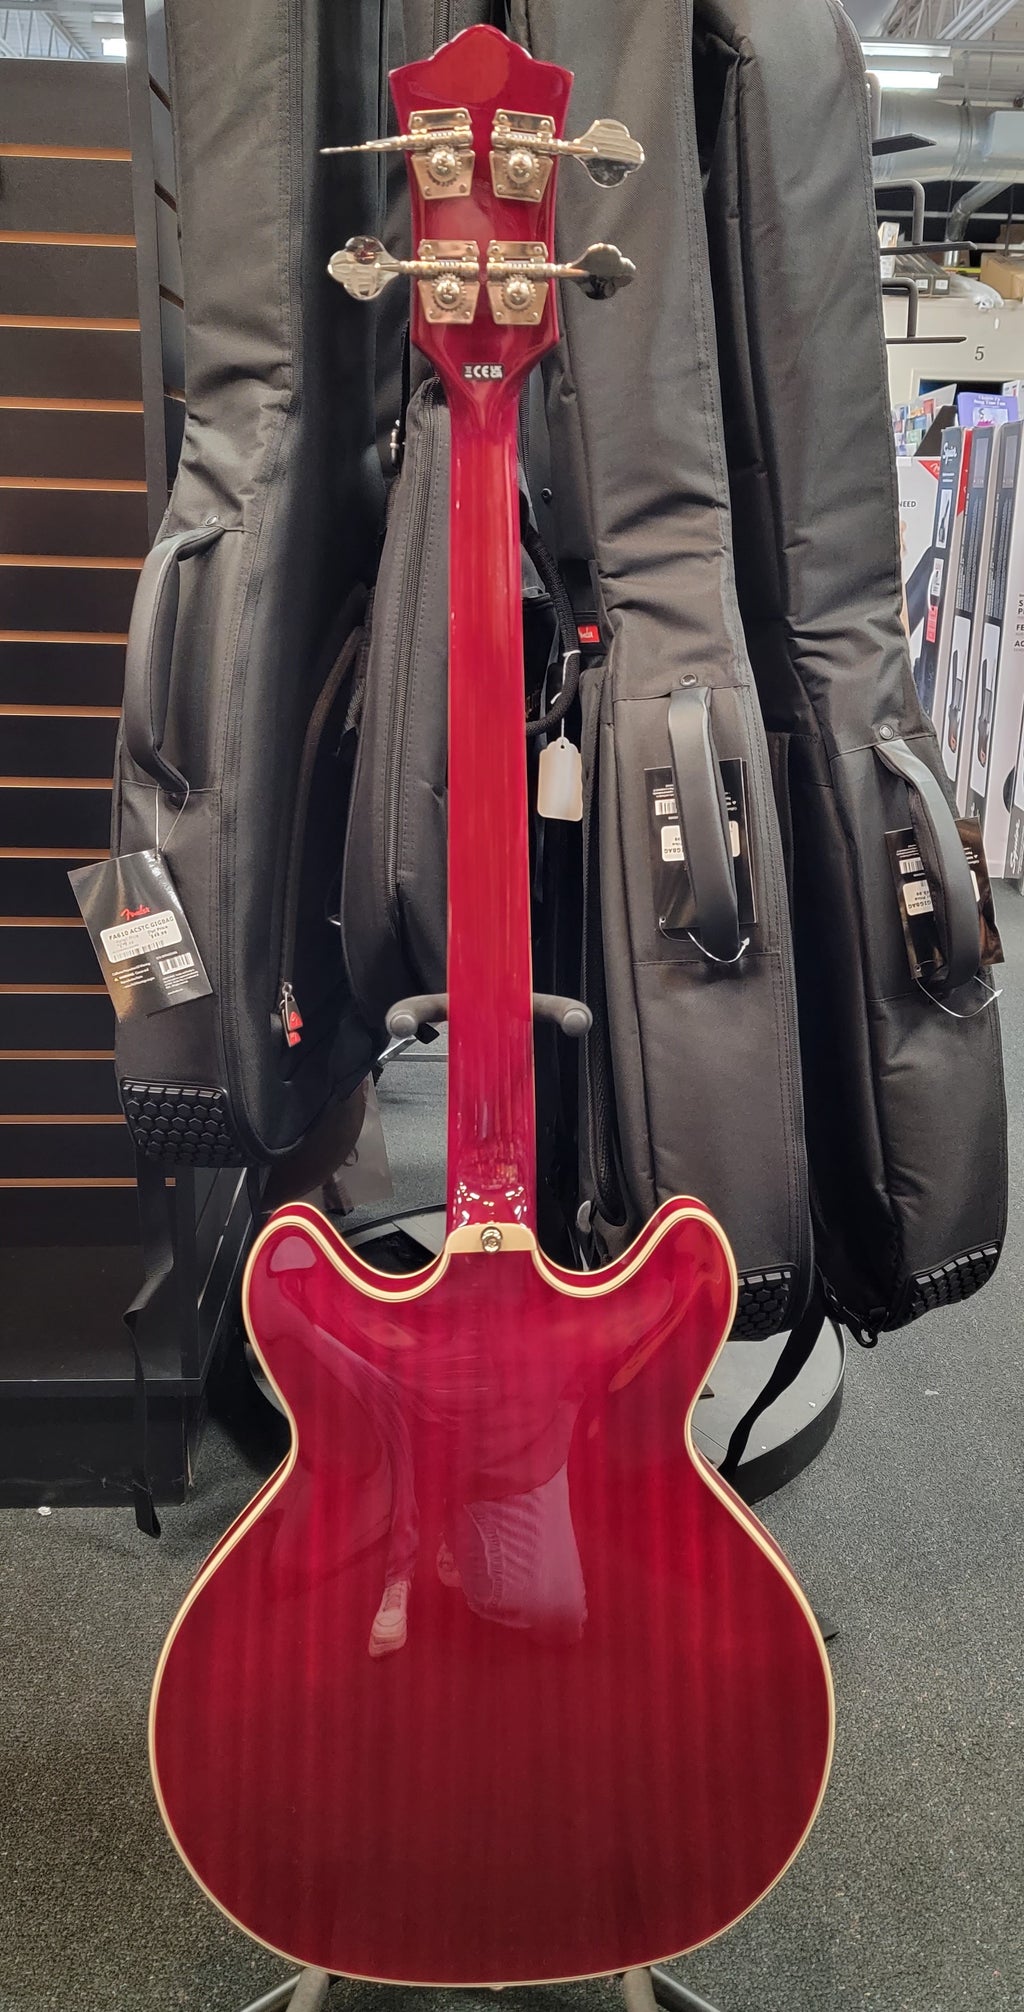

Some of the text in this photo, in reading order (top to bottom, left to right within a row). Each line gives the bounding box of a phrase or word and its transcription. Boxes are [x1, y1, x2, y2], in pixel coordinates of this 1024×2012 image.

[974, 346, 984, 360] 5
[120, 904, 151, 921] Fender
[109, 930, 129, 941] FA610
[150, 915, 174, 928] GIGBAG
